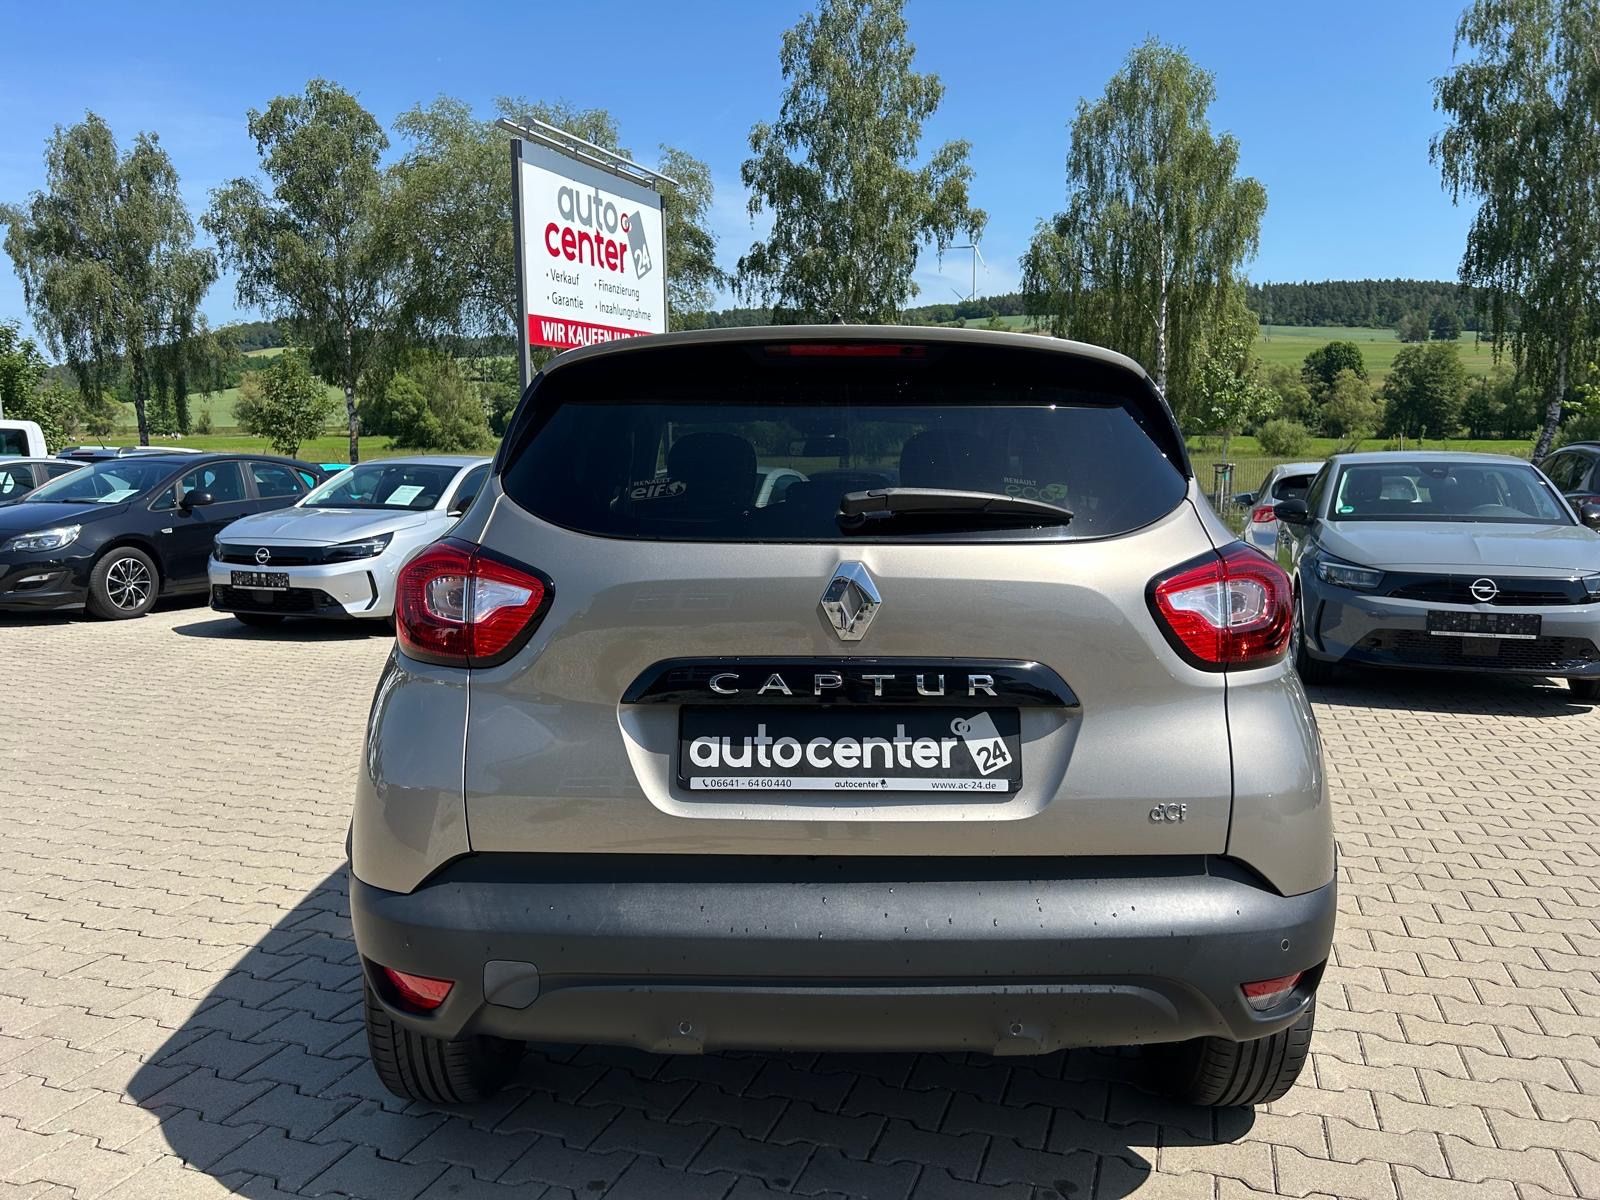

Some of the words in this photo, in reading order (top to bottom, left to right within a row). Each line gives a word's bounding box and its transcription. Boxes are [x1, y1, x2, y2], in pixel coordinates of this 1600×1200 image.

[558, 186, 618, 233] auto
[545, 222, 627, 273] center
[634, 244, 651, 276] 24
[550, 268, 580, 286] Verkauf
[552, 291, 584, 309] Garantie
[599, 279, 640, 301] Finanzierung
[599, 301, 651, 320] Inzahlungnahme
[541, 320, 565, 343] WIR
[1003, 477, 1037, 486] RENAULT
[709, 673, 998, 696] CAPTUR
[689, 724, 958, 769] autocenter
[976, 740, 1007, 771] 24
[834, 779, 879, 788] autocenter
[931, 781, 997, 790] www.ac-24.de
